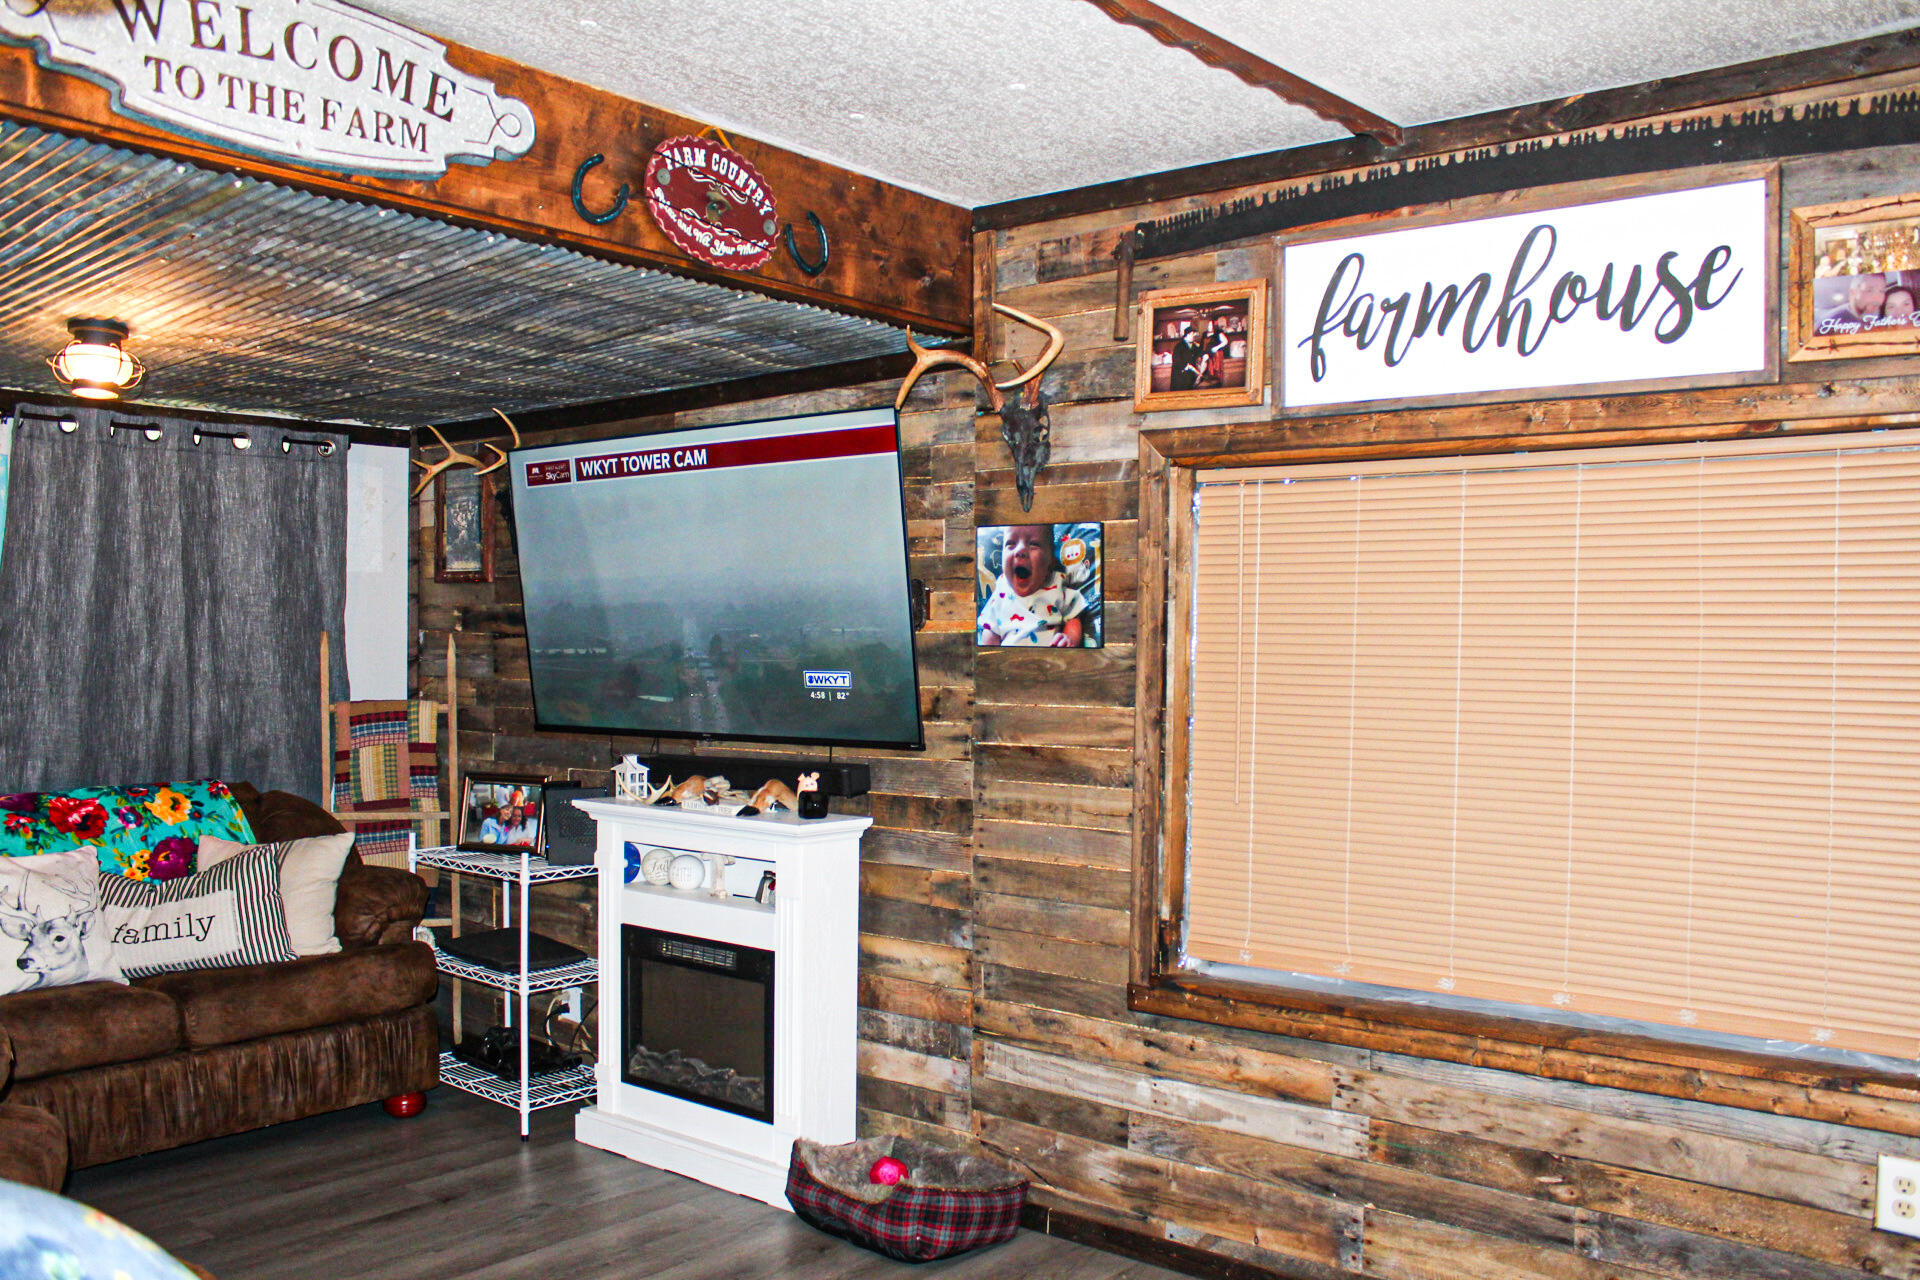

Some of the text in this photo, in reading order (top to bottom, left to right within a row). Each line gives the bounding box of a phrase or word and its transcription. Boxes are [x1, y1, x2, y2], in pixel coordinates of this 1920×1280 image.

[112, 0, 457, 123] WELCOME
[144, 56, 429, 153] TO THE FARM
[662, 147, 773, 216] FARM COUNTRY
[1298, 224, 1744, 382] farmhouse
[1820, 318, 1860, 334] Happy
[1863, 313, 1907, 330] Father's
[580, 448, 708, 477] WKYT TOWER CAM
[811, 691, 825, 699] 4:58
[814, 675, 847, 684] WKYT
[111, 912, 216, 945] family
